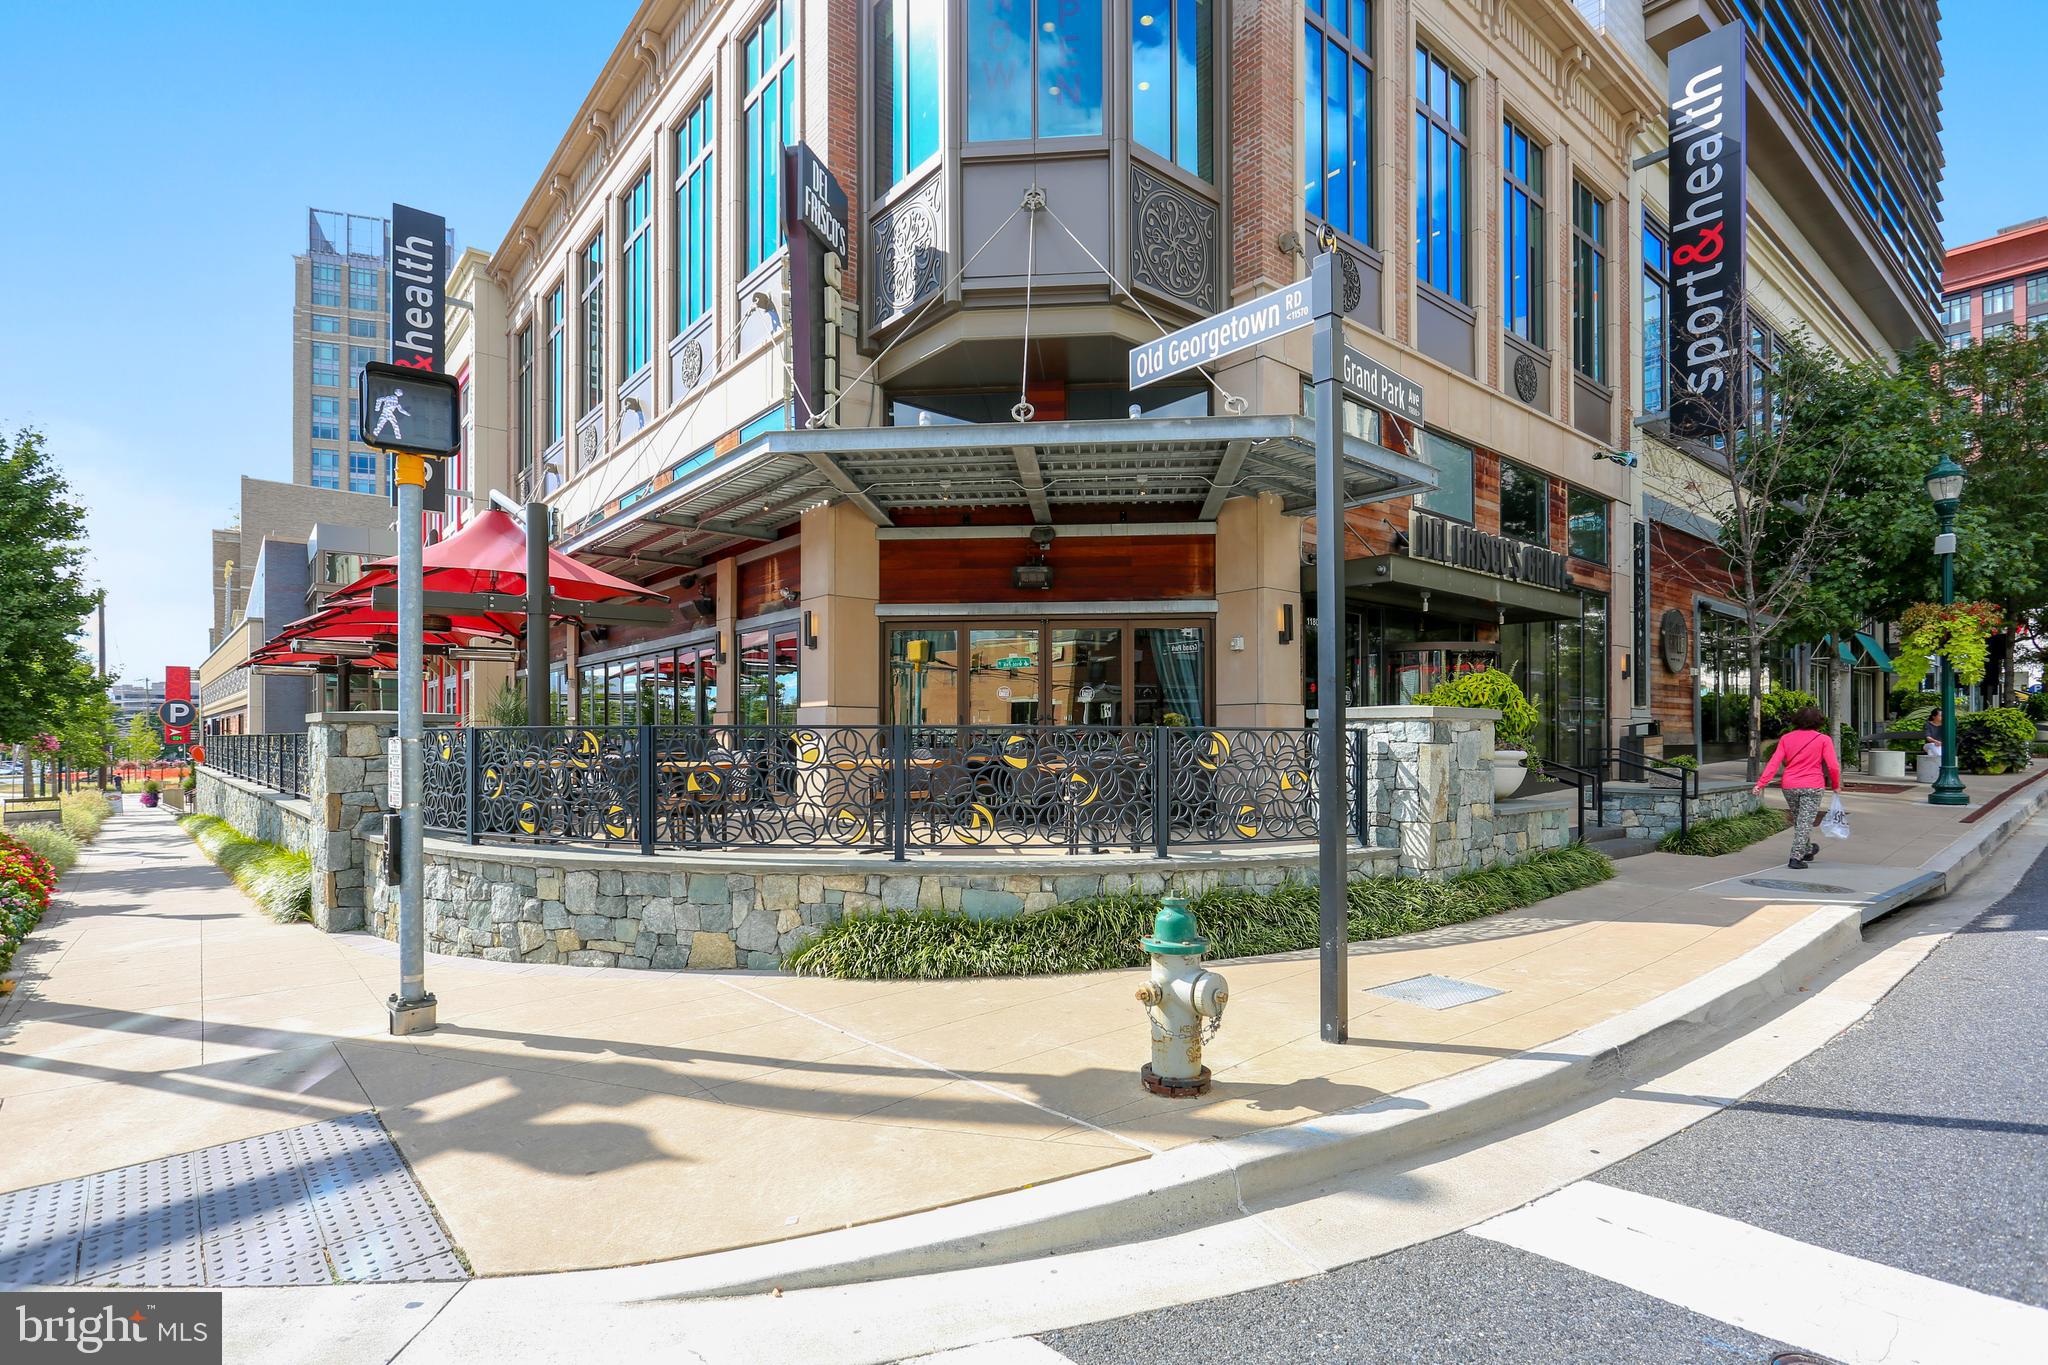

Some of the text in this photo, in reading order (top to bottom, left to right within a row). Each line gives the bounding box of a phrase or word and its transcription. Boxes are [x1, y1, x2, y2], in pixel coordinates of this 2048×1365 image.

[812, 160, 830, 207] DEL
[805, 185, 846, 257] FRISCO'S
[1136, 290, 1302, 378] Old Georgetown RD
[1343, 354, 1420, 410] Grand Park Ave
[1416, 515, 1451, 562] DEL
[170, 703, 190, 724] P
